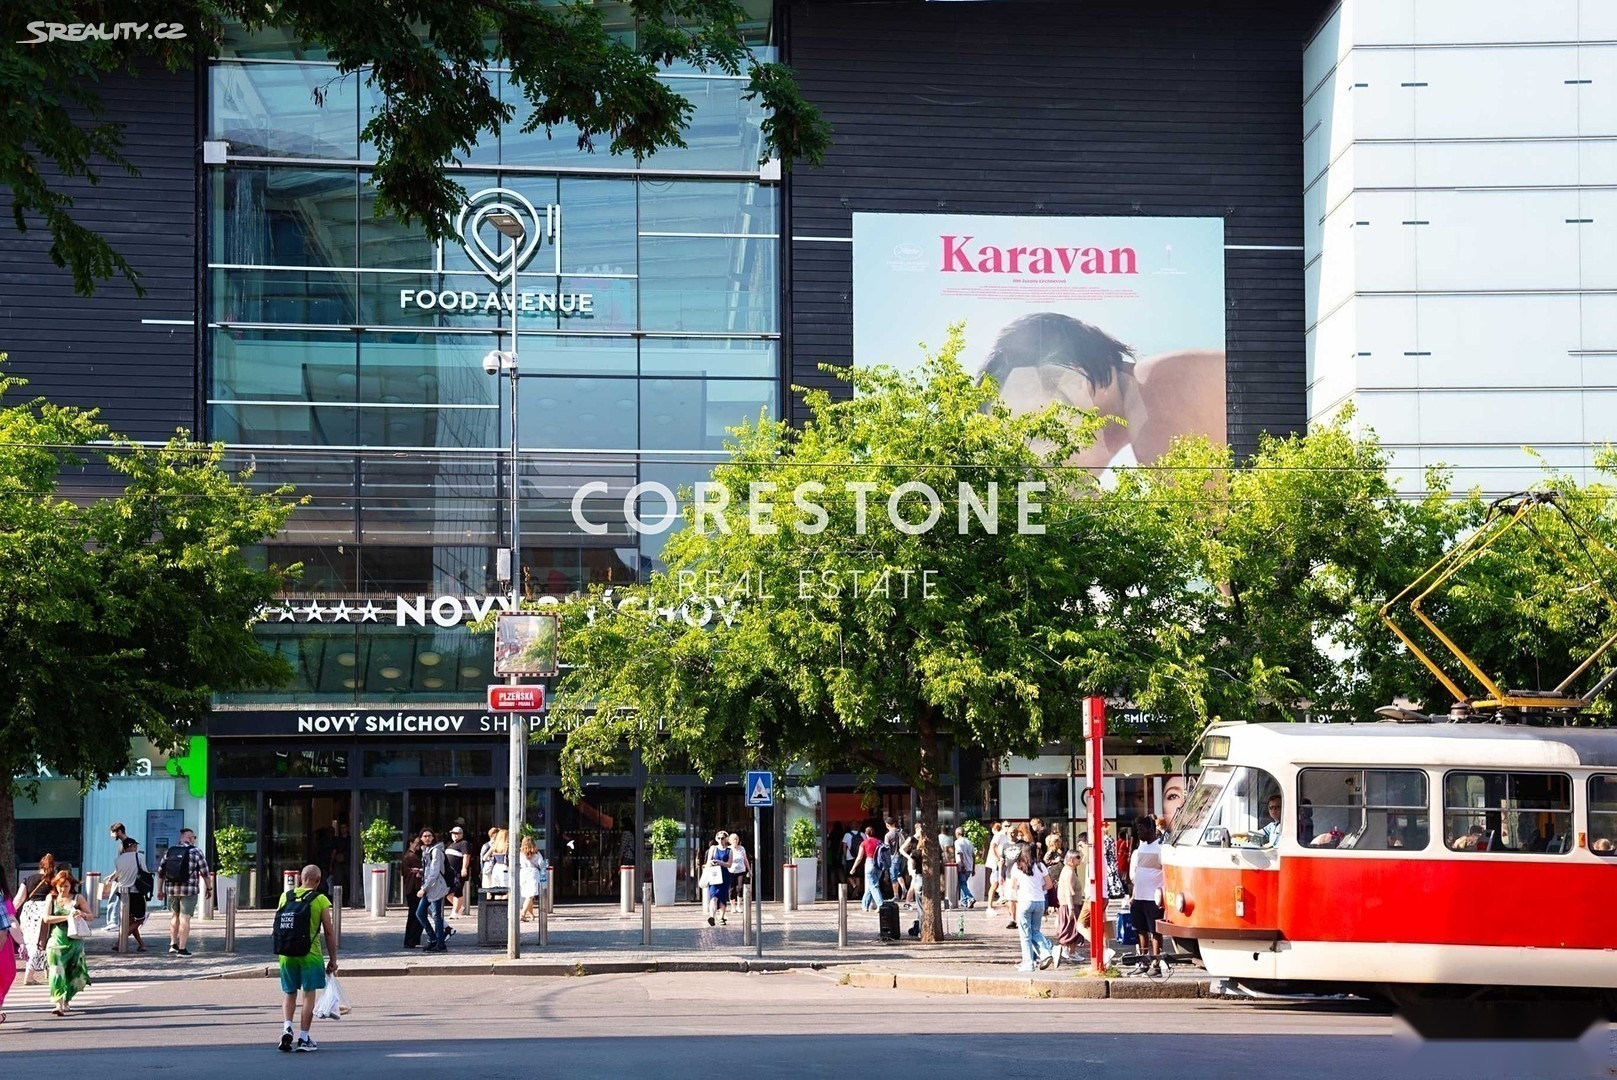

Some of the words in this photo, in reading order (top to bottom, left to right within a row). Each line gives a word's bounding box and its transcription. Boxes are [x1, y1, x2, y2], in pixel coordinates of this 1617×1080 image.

[939, 234, 1139, 275] Karavan
[400, 289, 477, 310] FOOD
[484, 291, 593, 312] AVENUE
[498, 691, 534, 700] PLZEŇSKÁ
[298, 711, 358, 733] NOVÝ
[366, 711, 465, 733] SMÍCHOV
[479, 714, 598, 732] SHPPING
[1066, 758, 1118, 772] ARNI
